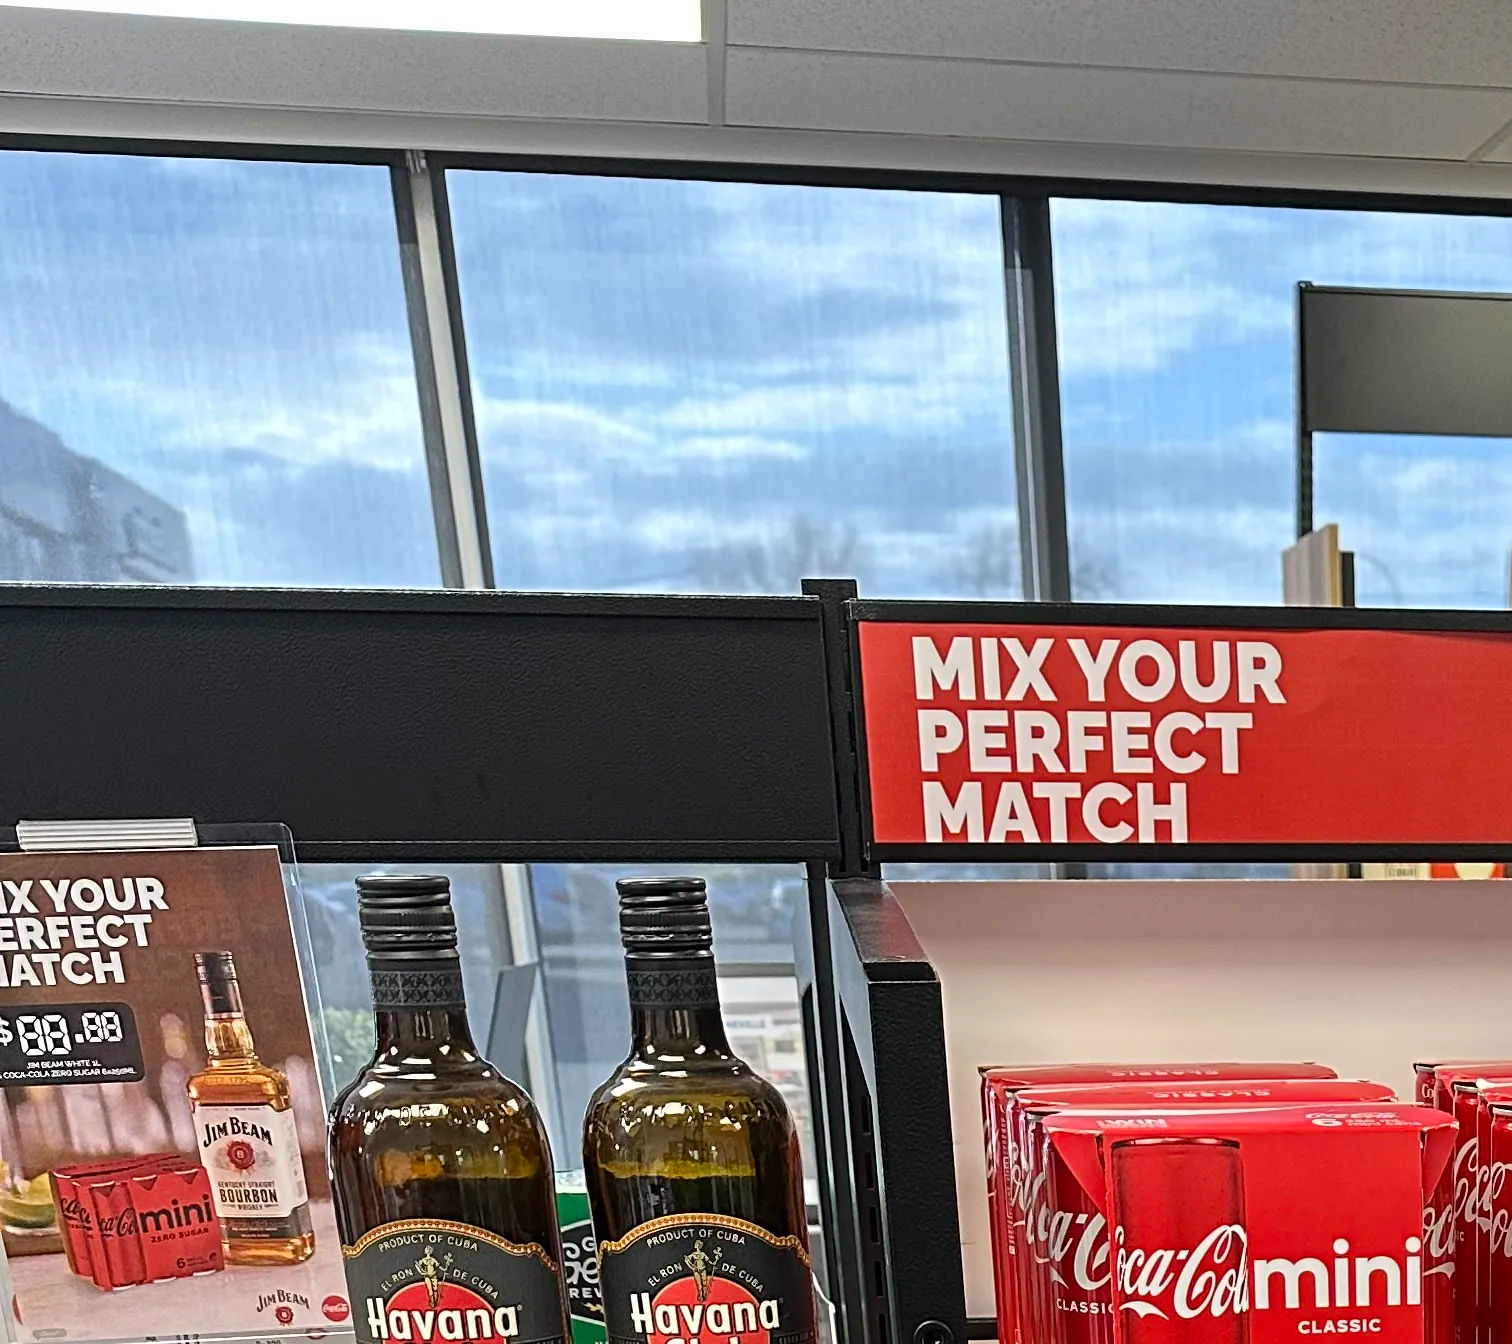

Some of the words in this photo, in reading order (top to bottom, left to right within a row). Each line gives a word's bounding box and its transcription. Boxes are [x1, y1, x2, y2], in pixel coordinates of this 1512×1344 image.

[913, 636, 1057, 701] MIX
[1067, 639, 1287, 705] YOUR
[918, 711, 1254, 774] PERFECT
[923, 781, 1189, 844] MATCH
[39, 878, 169, 910] YOUR
[203, 1123, 227, 1148] JIM
[230, 1117, 273, 1146] BEAM
[219, 1188, 279, 1204] BOURBON
[139, 1195, 213, 1233] mini
[379, 1234, 425, 1252] PRODUCT
[429, 1235, 443, 1243] OF
[447, 1236, 479, 1251] CUBA
[646, 1229, 694, 1247] PRODUCT
[699, 1229, 712, 1238] OF
[717, 1231, 745, 1245] CUBA
[391, 1268, 414, 1285] RON
[453, 1268, 469, 1279] DE
[471, 1275, 500, 1300] CUBA
[660, 1263, 683, 1280] RON
[721, 1263, 736, 1273] DE
[739, 1270, 763, 1292] CUBA
[1256, 1238, 1421, 1309] mini
[257, 1295, 276, 1312] JIM
[277, 1289, 310, 1310] BEAM
[630, 1293, 780, 1336] Havana
[366, 1297, 519, 1341] Havana
[1298, 1318, 1381, 1334] CLASSIC
